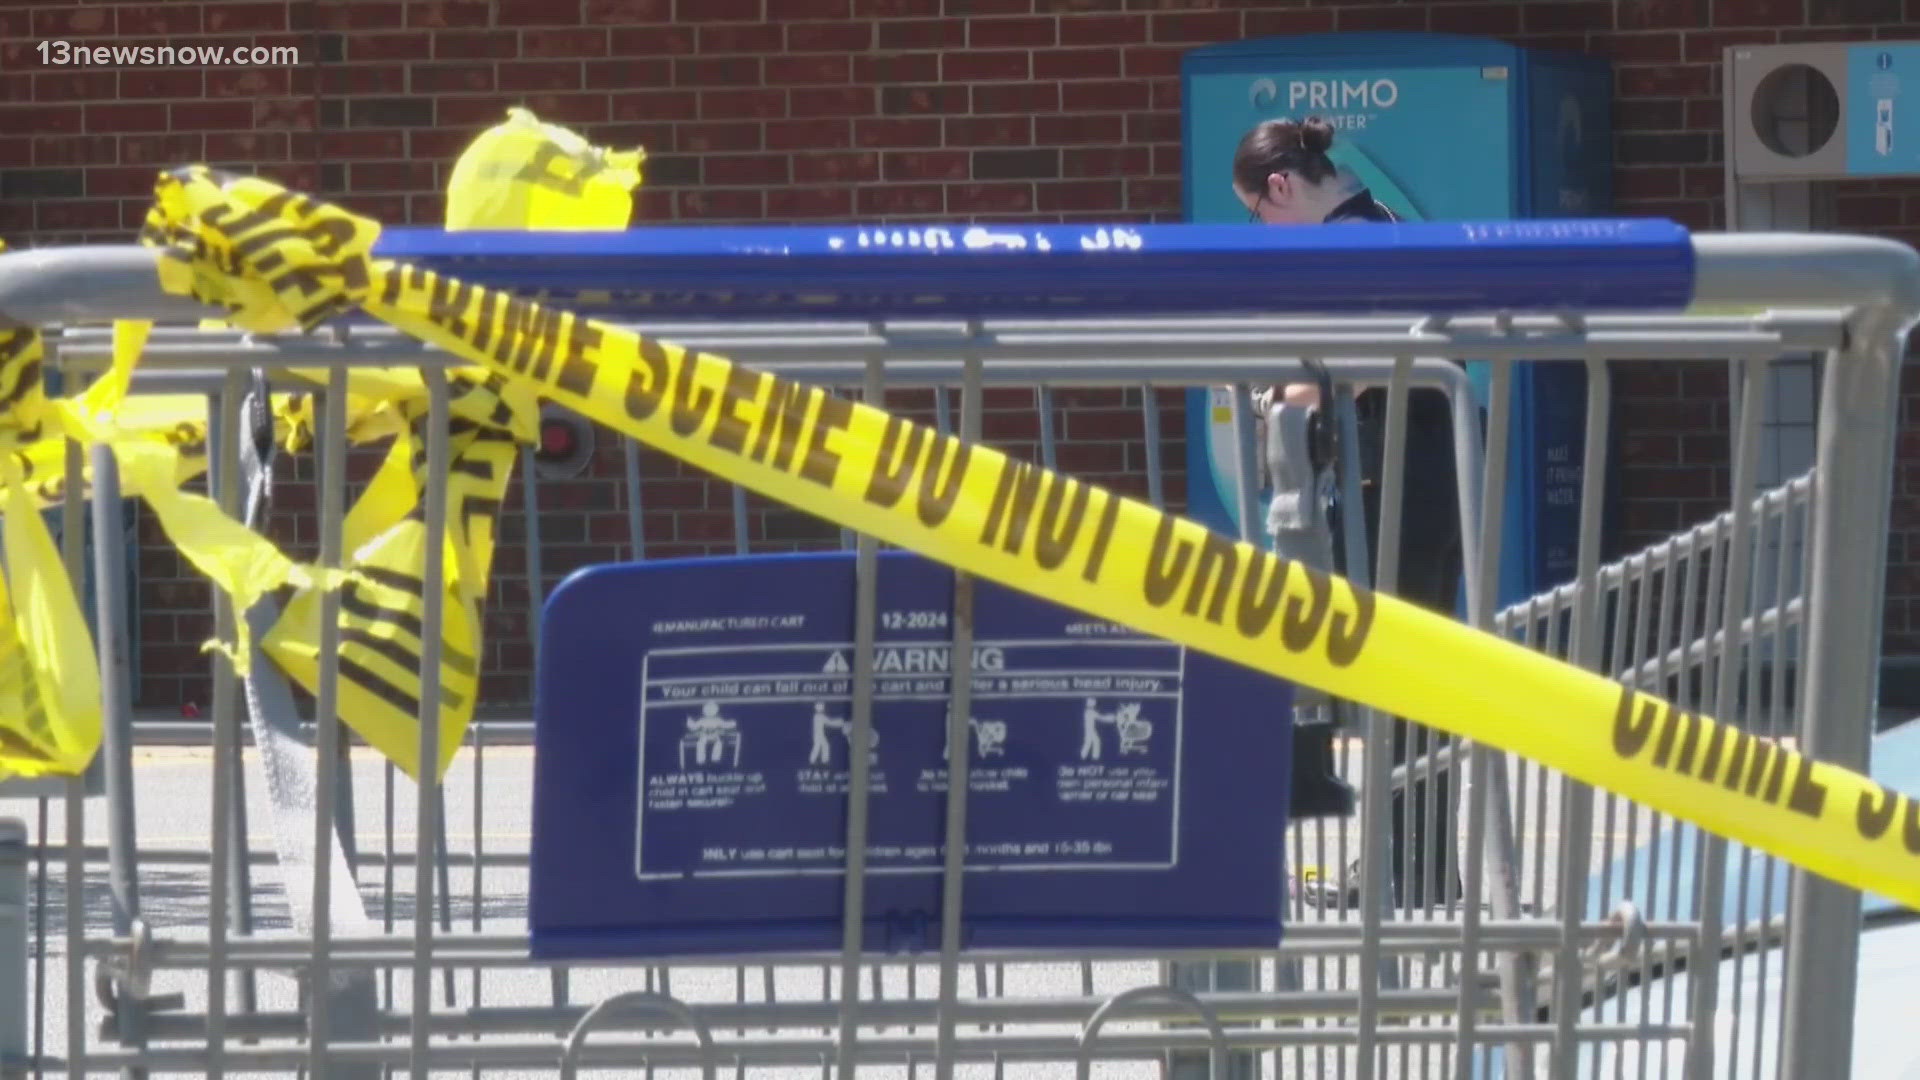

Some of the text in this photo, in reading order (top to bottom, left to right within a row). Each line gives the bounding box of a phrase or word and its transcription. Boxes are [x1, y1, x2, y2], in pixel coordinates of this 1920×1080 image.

[1288, 79, 1398, 109] PRIMO
[623, 334, 854, 489] SCENE
[863, 415, 972, 528] DO
[978, 455, 1121, 584] NOT
[1143, 510, 1377, 668] CROSS
[882, 612, 948, 629] 12-2024
[662, 684, 697, 697] Your
[702, 681, 739, 696] child
